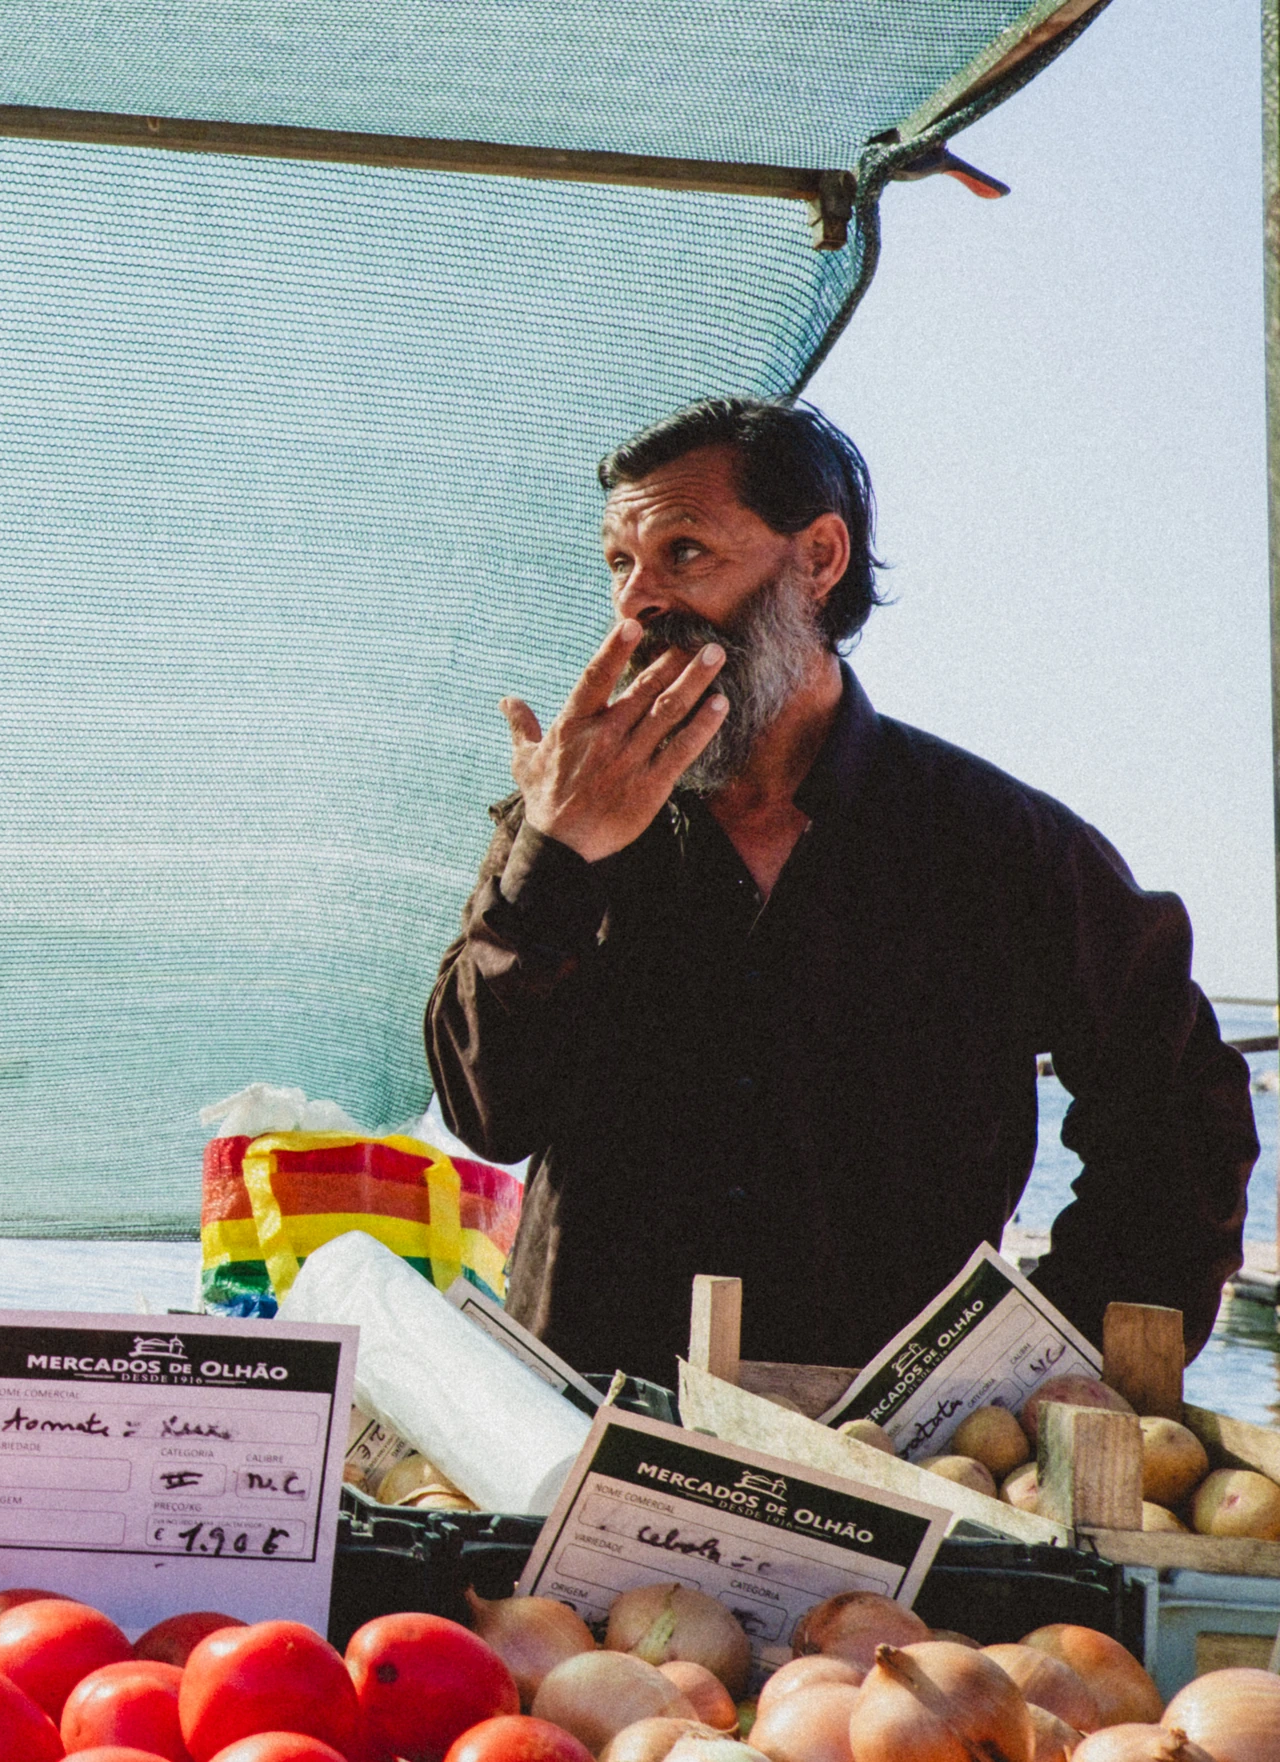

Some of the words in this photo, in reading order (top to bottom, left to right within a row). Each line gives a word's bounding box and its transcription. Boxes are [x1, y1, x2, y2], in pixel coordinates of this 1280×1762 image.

[27, 1354, 161, 1374] MERCADOS
[169, 1363, 192, 1374] DE
[200, 1360, 288, 1381] OLHÃO
[866, 1364, 923, 1423] RCADOS
[923, 1348, 938, 1363] DE
[937, 1300, 984, 1348] OLHÃO
[121, 1374, 168, 1383] DESDE
[173, 1375, 203, 1385] 1916
[24, 1388, 80, 1399] COMERCIAL
[160, 1448, 214, 1458] CATEGORIA
[245, 1454, 284, 1463] CALIBRE
[153, 1501, 202, 1513] PREÇO/KG
[596, 1482, 622, 1499] NOME
[624, 1492, 675, 1514] COMERCIAL
[637, 1462, 760, 1509] MERCADOS
[765, 1502, 788, 1517] DE
[794, 1508, 874, 1543] OLHÃO
[719, 1500, 762, 1519] DESDE
[766, 1515, 794, 1529] 1916
[574, 1532, 623, 1554] VARIEDADE
[550, 1581, 589, 1599] ORIGEM
[730, 1579, 780, 1601] CATEGORIA
